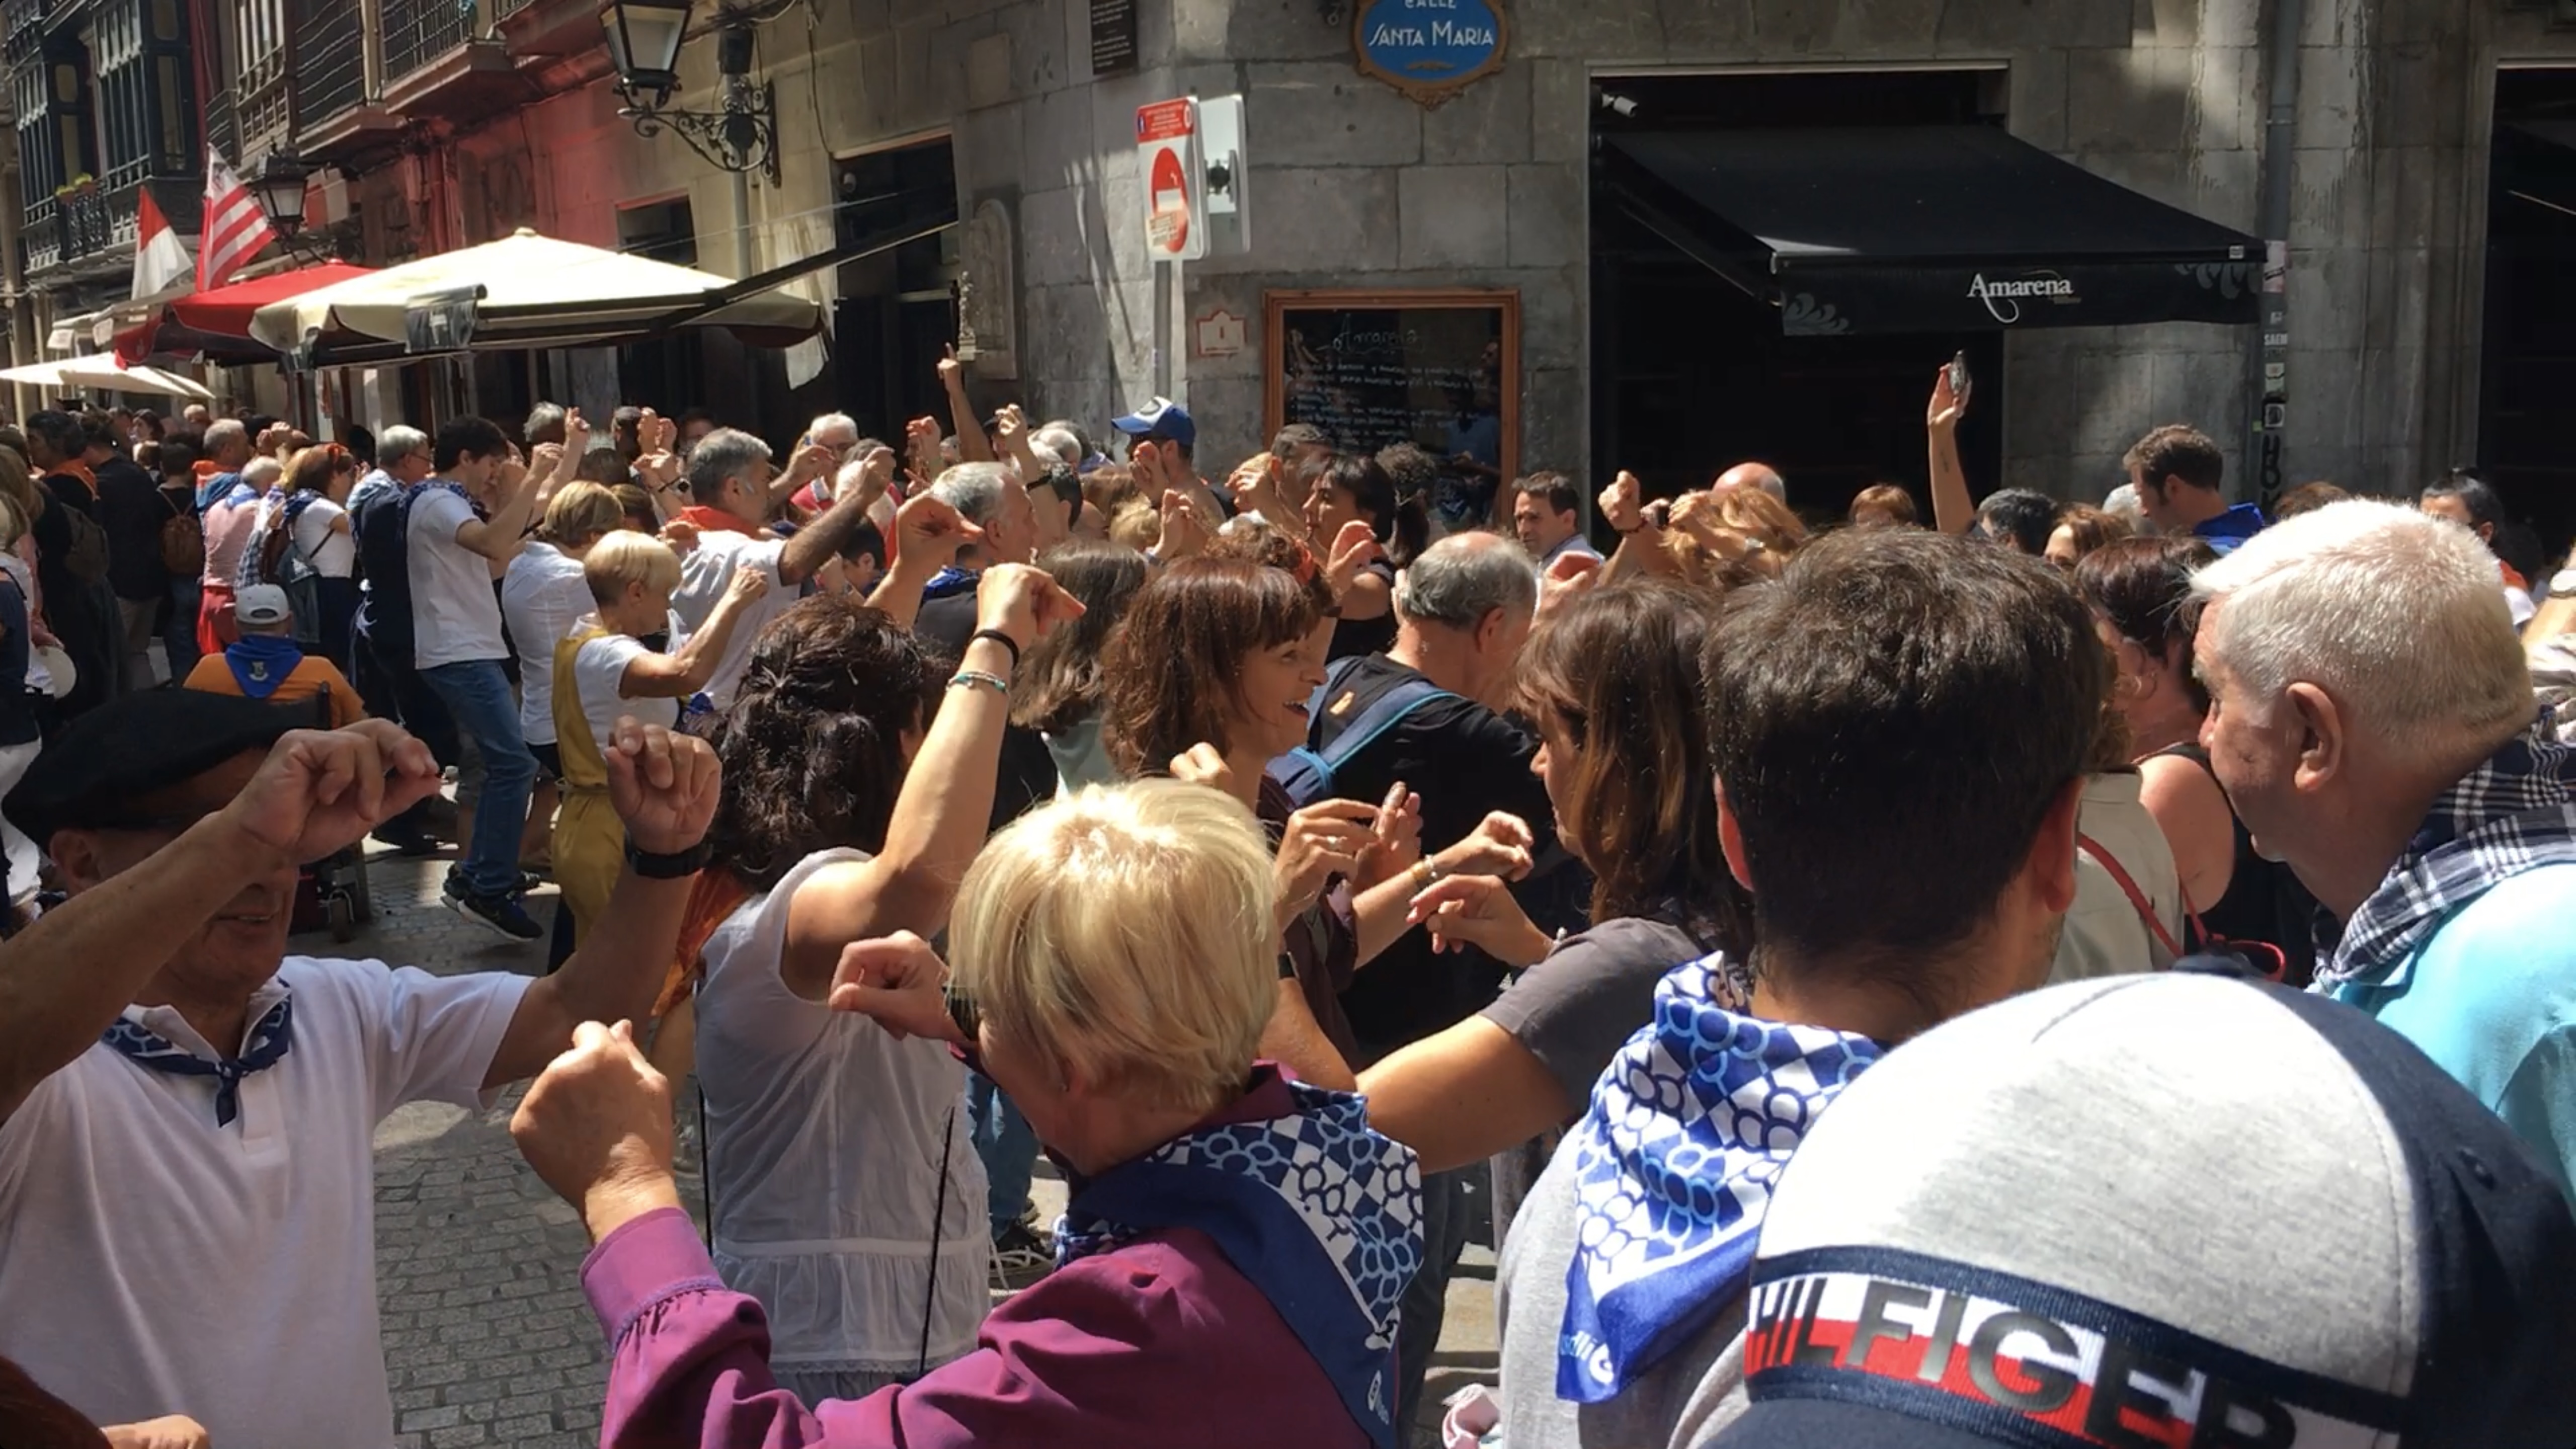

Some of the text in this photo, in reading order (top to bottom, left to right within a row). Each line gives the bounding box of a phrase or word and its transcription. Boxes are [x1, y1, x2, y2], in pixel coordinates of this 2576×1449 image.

[1404, 0, 1457, 9] CALLE
[1369, 20, 1494, 46] SANTA MARIA
[1966, 272, 2074, 323] Amarena
[1752, 1276, 2296, 1449] HILFIGER
